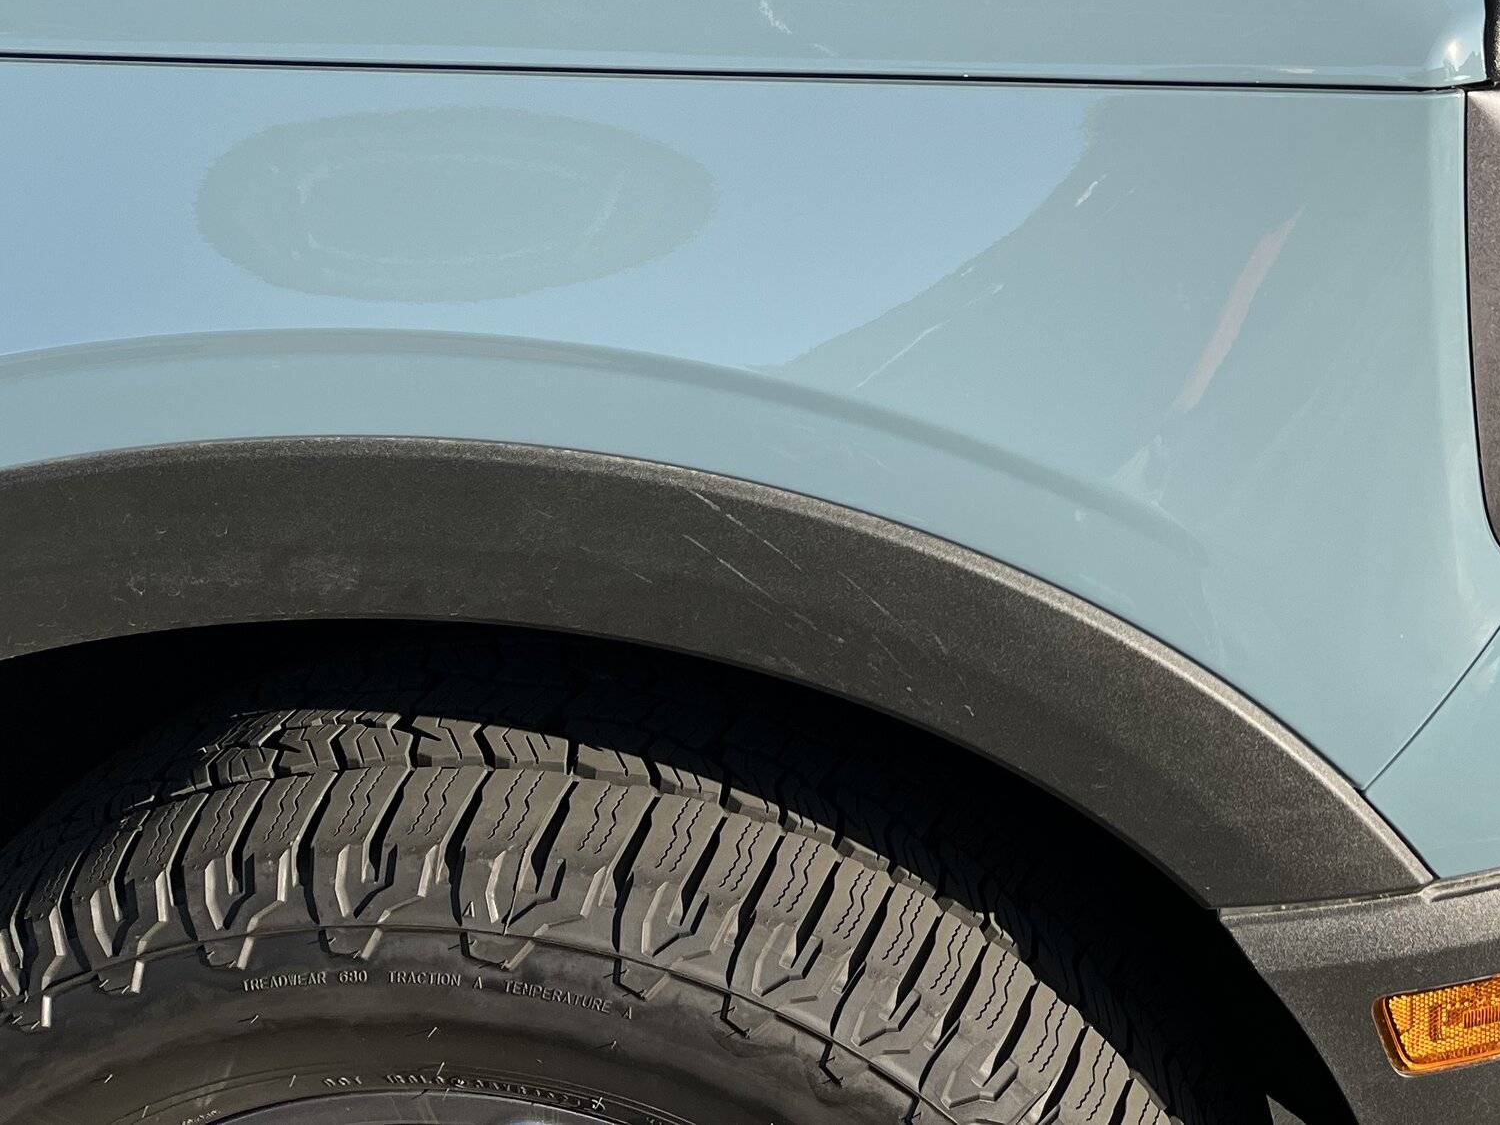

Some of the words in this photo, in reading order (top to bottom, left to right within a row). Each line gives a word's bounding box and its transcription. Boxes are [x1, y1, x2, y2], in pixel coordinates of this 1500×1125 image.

[243, 971, 327, 992] TREADWEAR
[387, 970, 461, 987] TRACTION
[472, 976, 483, 989] A
[504, 979, 613, 1013] TEMPERATURE
[621, 1006, 633, 1020] A
